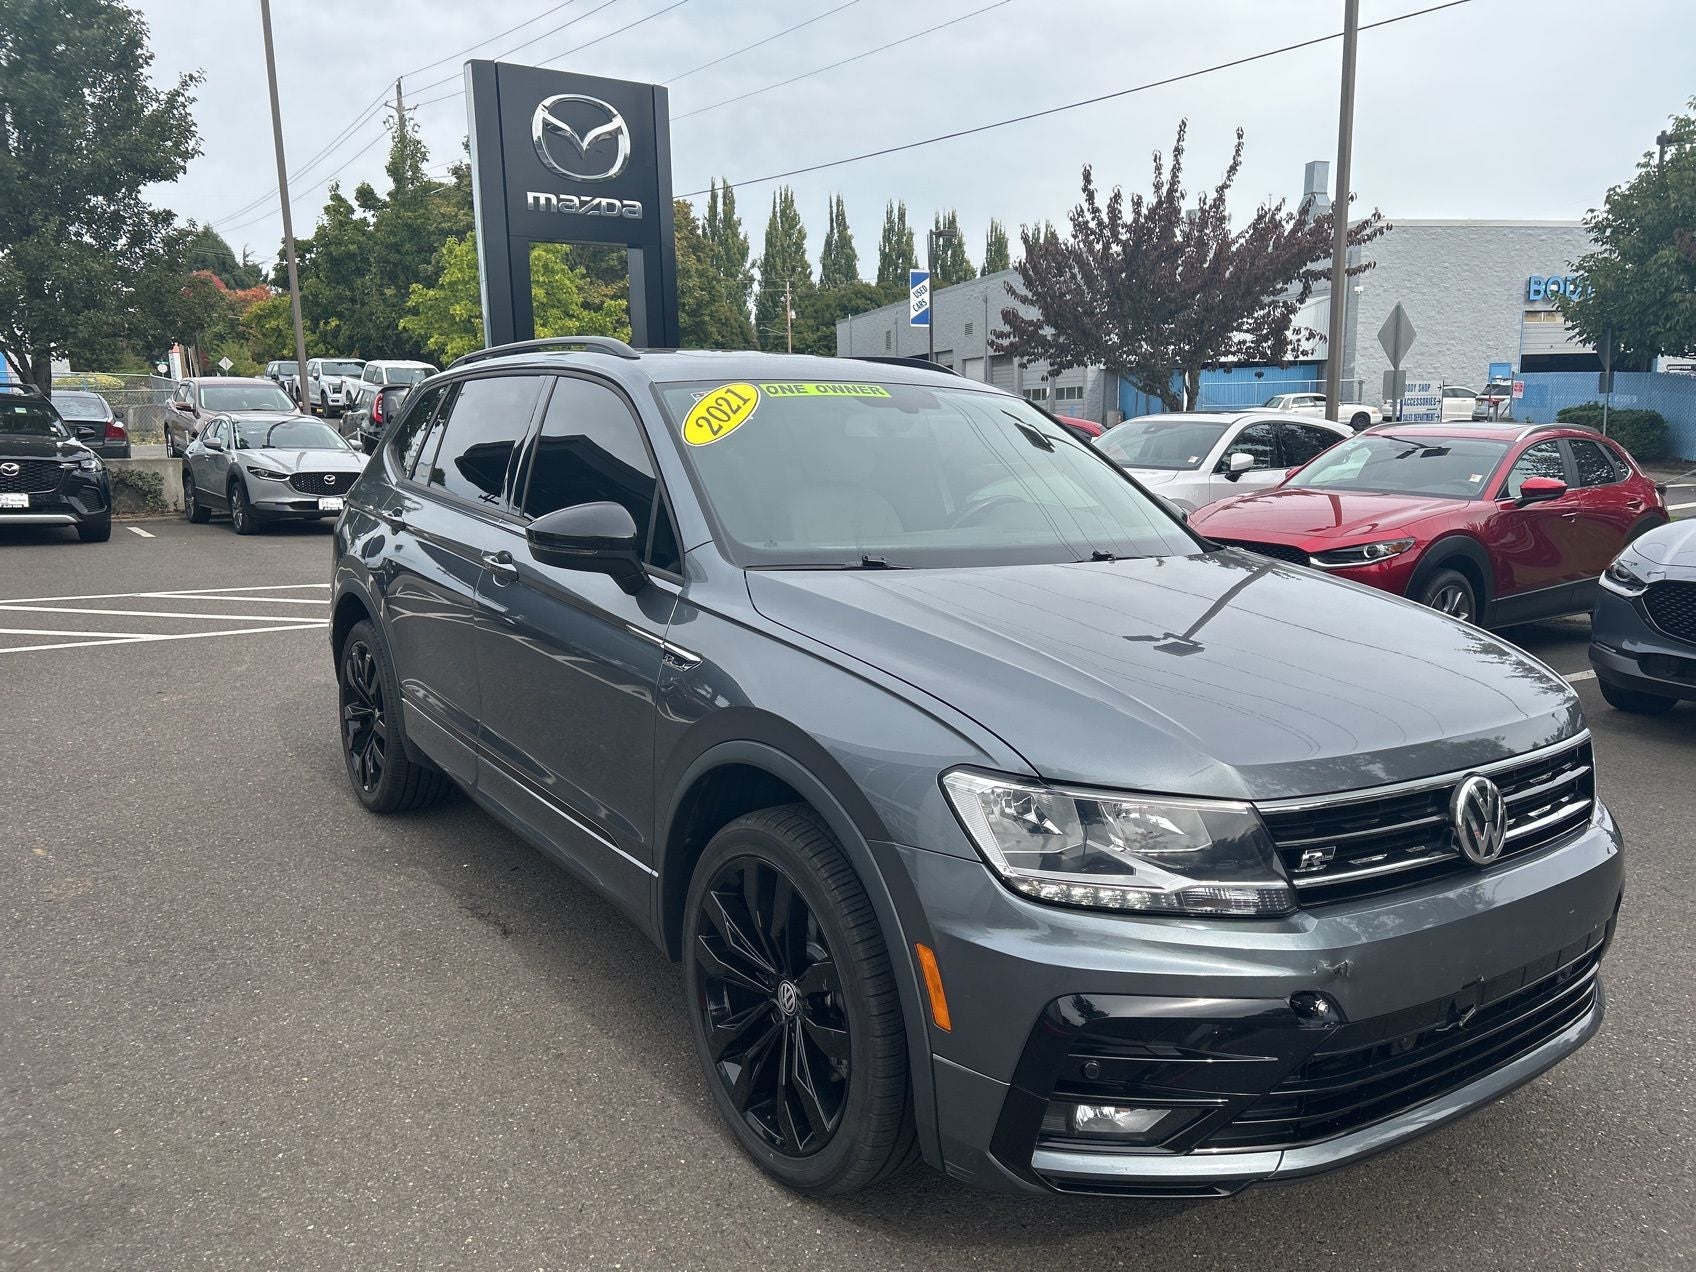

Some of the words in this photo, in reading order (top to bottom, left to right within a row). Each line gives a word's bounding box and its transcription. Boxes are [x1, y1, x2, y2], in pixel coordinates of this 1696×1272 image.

[526, 191, 643, 219] mazda
[912, 284, 929, 299] USED
[1529, 275, 1594, 301] BOD
[912, 298, 929, 312] CARS
[765, 384, 809, 395] ONE
[815, 384, 886, 395] OWNER
[1418, 384, 1430, 392] SHOP
[1403, 397, 1436, 406] ACCESSORIES
[696, 388, 751, 436] 2021
